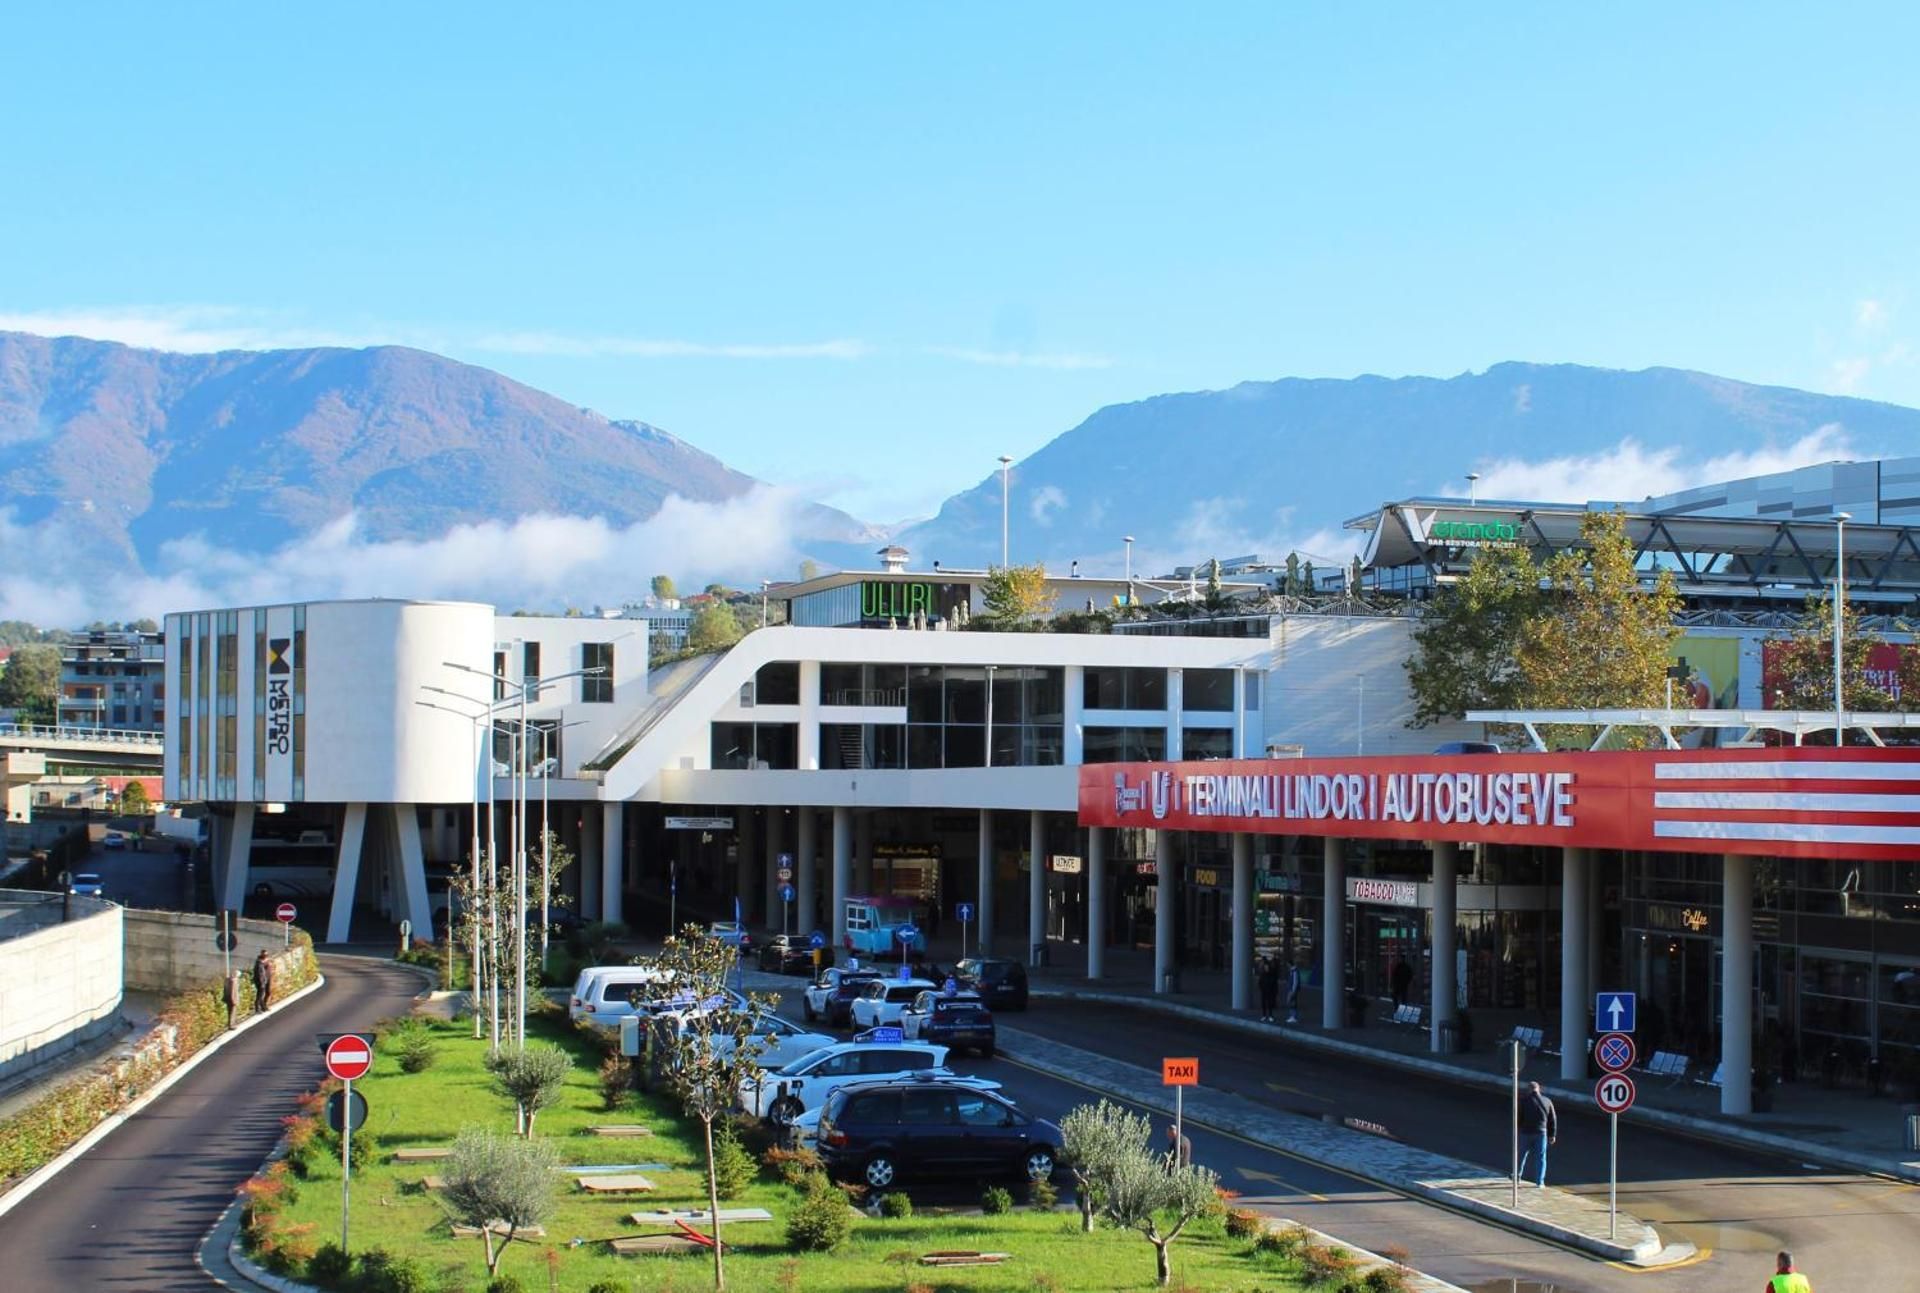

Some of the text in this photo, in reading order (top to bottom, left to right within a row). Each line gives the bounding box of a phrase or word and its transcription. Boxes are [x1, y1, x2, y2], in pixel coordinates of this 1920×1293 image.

[269, 680, 278, 755] HOTEL
[277, 679, 290, 755] METRO
[1186, 775, 1280, 818] TERMINALI
[1283, 774, 1366, 821] LINDOR
[1382, 773, 1576, 827] AUTOBUSEVE
[1353, 881, 1394, 900] TOBACCO
[1681, 908, 1709, 927] Coffee
[1168, 1066, 1194, 1077] TAXI
[1603, 1084, 1627, 1102] 10
